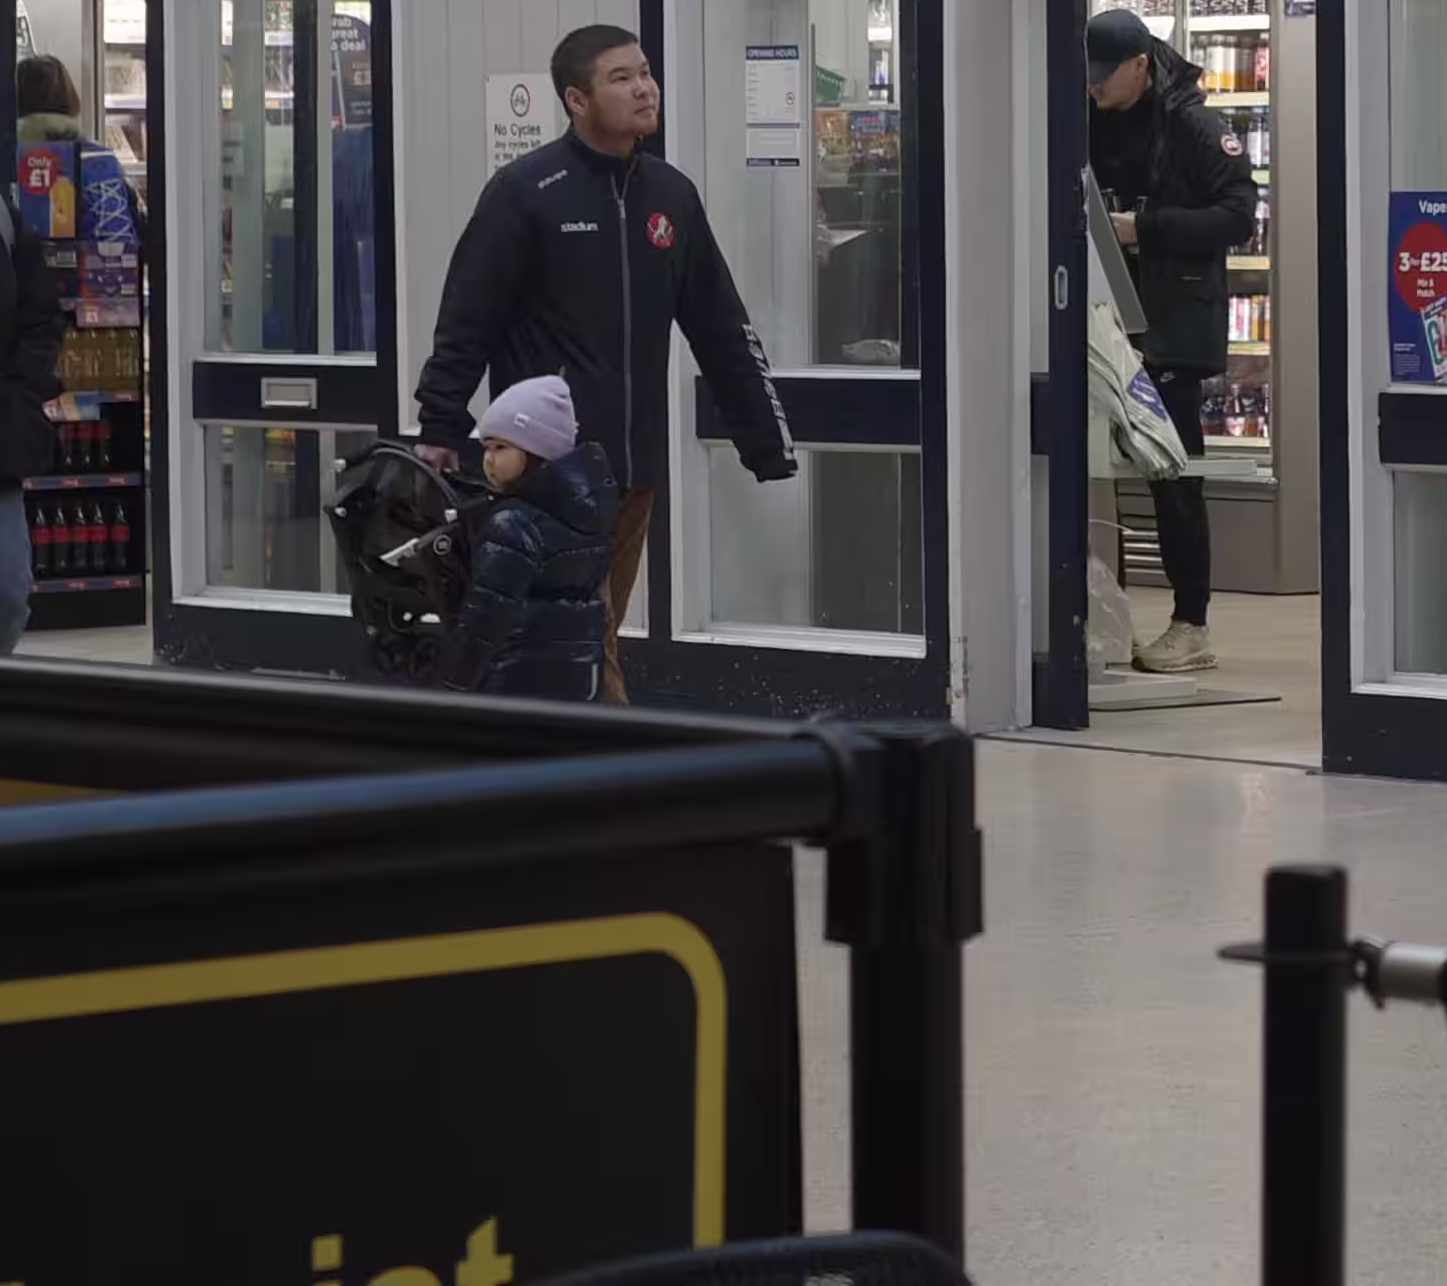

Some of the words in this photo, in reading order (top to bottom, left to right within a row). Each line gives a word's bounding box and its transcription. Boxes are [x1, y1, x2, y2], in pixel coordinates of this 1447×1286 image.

[494, 123, 507, 137] No
[511, 123, 542, 139] Cycles
[27, 156, 51, 169] Only
[29, 168, 51, 188] £1
[1398, 251, 1410, 272] 3
